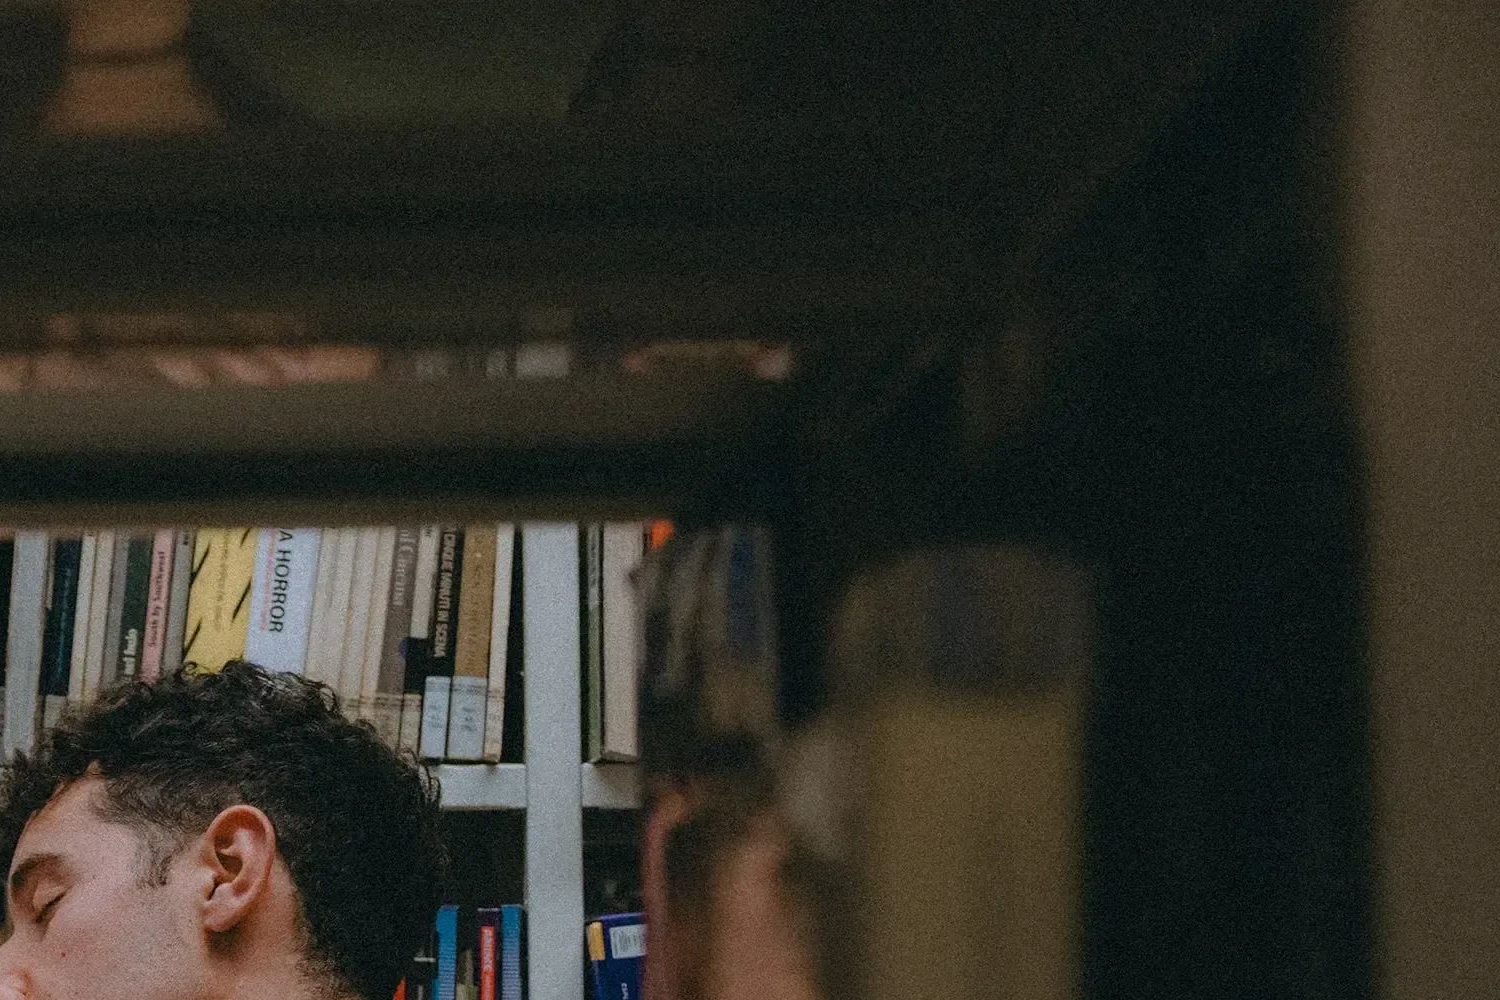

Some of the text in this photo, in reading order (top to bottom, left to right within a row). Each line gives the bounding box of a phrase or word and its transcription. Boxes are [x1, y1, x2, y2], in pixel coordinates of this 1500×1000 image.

[279, 530, 293, 542] A
[441, 533, 456, 570] CINQUE
[146, 550, 167, 647] South by Southwest
[268, 549, 290, 634] HORROR
[437, 572, 453, 608] MINUTI
[437, 610, 448, 621] IN
[433, 622, 448, 657] SCENA
